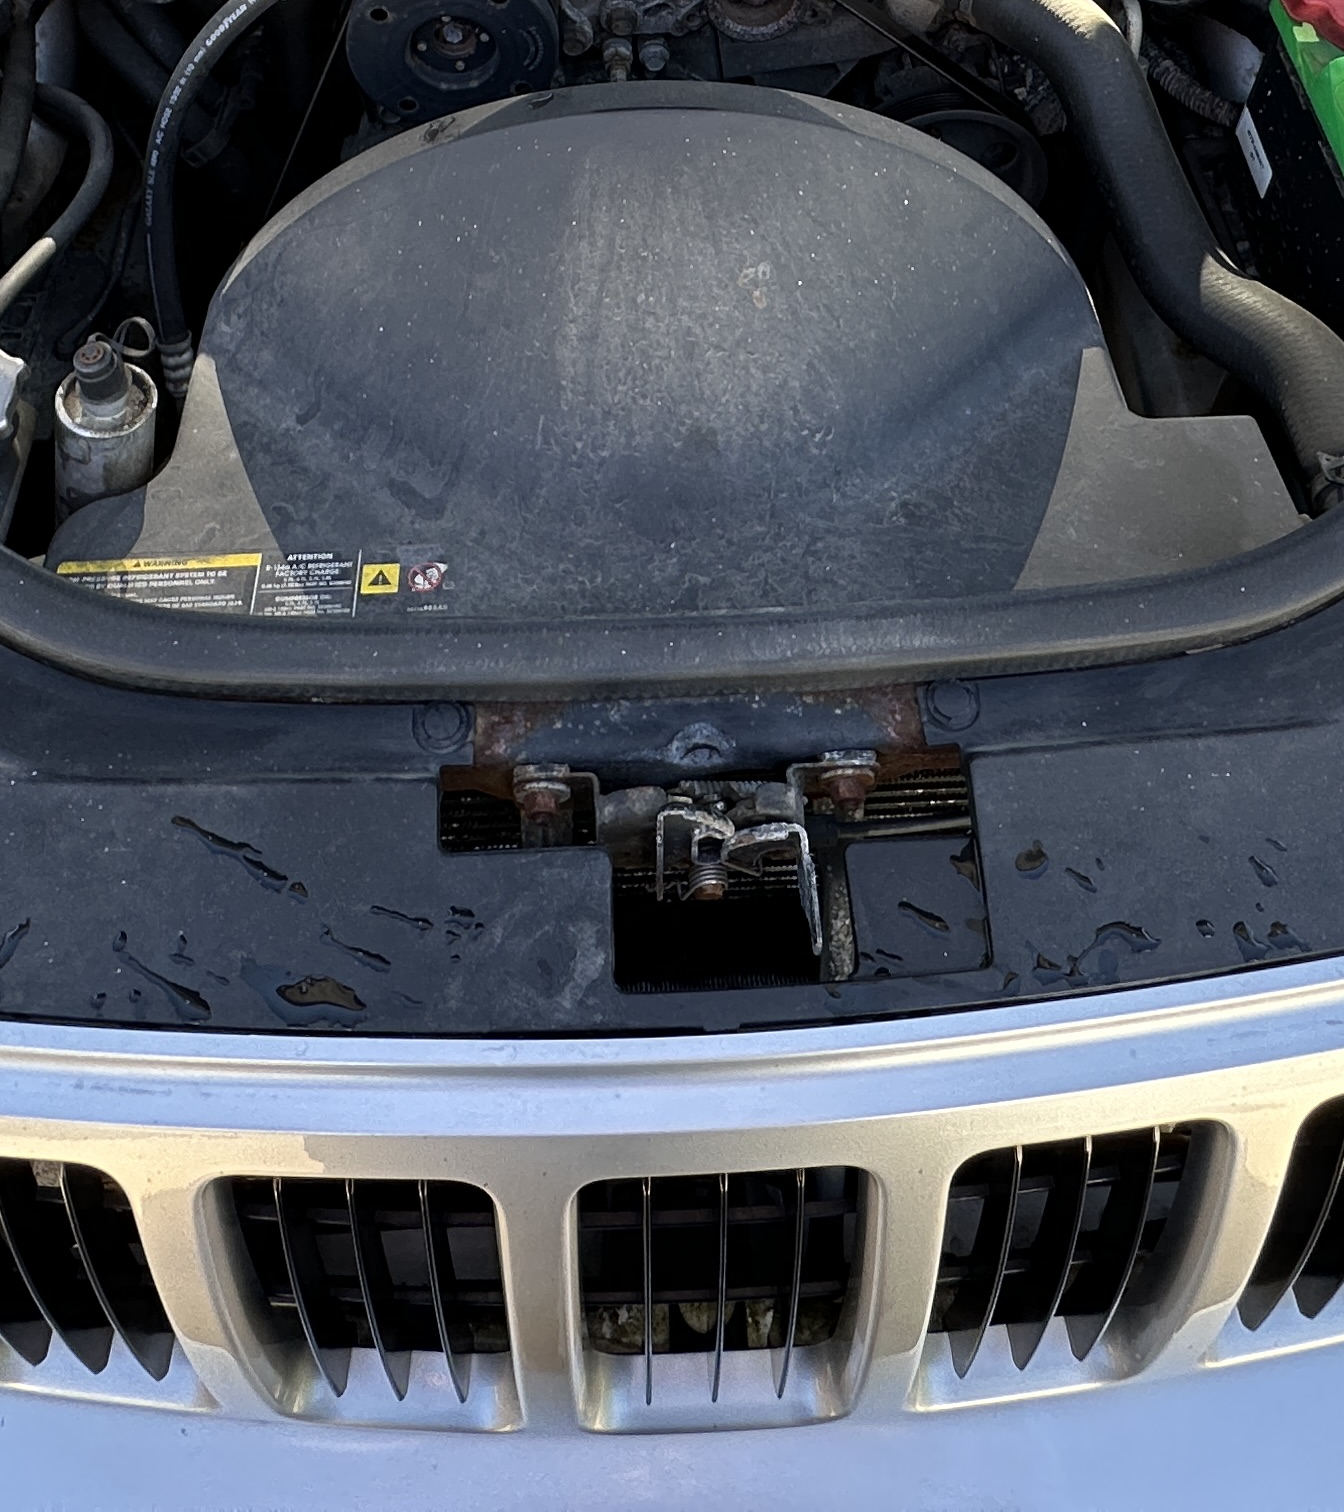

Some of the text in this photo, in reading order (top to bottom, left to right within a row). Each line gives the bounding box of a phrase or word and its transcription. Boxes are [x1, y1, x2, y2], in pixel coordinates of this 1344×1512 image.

[205, 3, 248, 47] GOODYEAR
[286, 553, 333, 561] ATTENTION
[143, 559, 188, 567] WARNING
